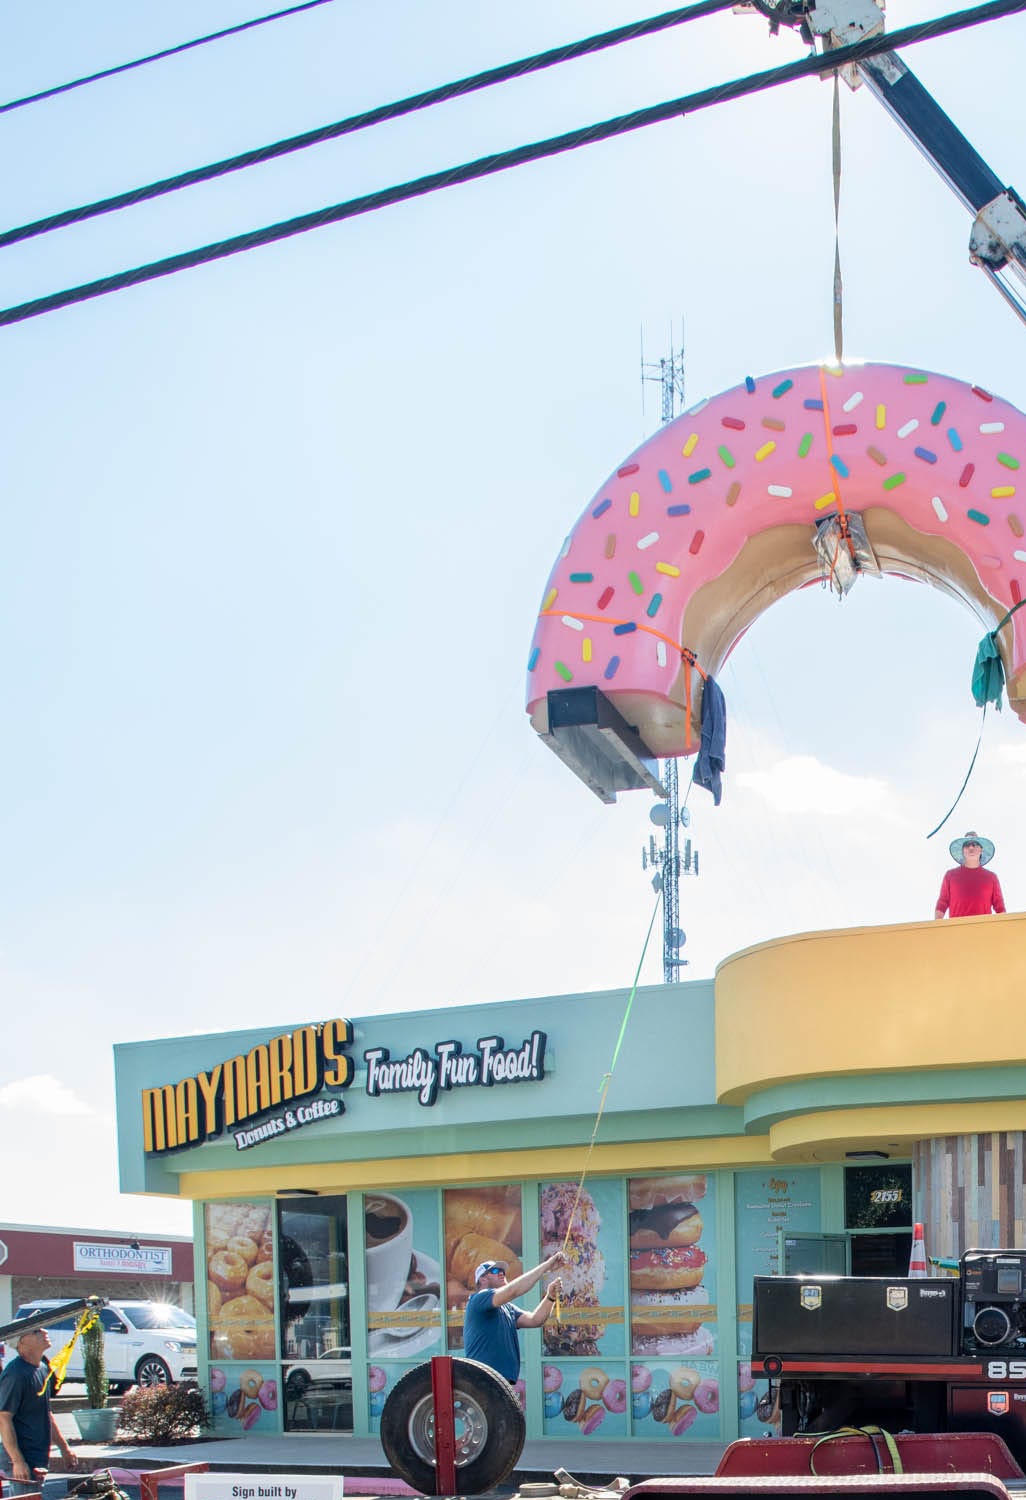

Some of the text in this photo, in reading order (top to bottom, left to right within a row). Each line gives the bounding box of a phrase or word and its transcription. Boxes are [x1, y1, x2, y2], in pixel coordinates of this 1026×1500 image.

[365, 1034, 540, 1104] Family Fun Food!
[142, 1018, 351, 1153] MAYNARD'S
[235, 1099, 340, 1150] Donuts & Coffee
[875, 1190, 899, 1202] 2155
[80, 1247, 166, 1260] ORTHODONTIST
[232, 1486, 297, 1498] Sign built by
